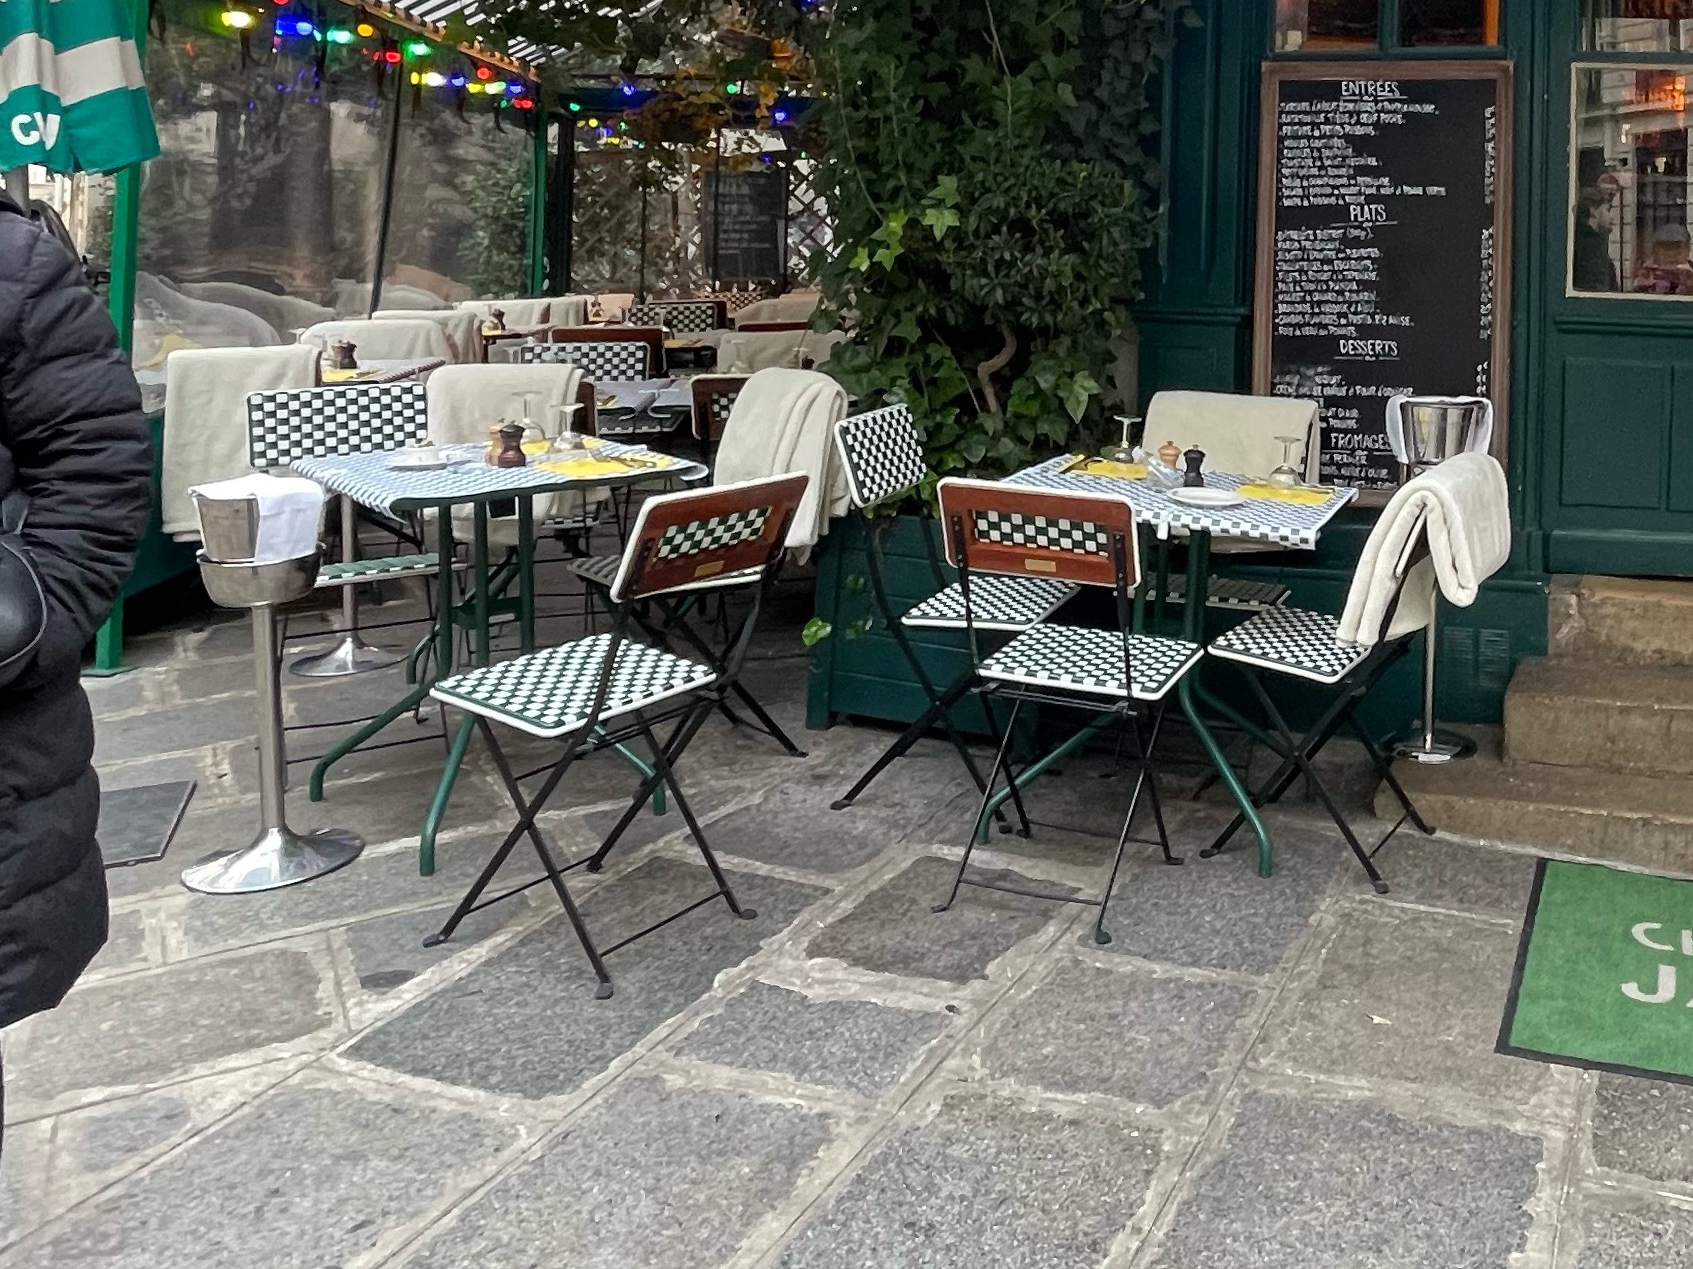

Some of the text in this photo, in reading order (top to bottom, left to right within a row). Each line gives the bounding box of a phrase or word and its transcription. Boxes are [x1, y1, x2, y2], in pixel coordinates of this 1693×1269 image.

[1341, 82, 1400, 96] ENTRÉES
[1350, 205, 1387, 221] PLATS
[1339, 339, 1398, 356] DESSERTS
